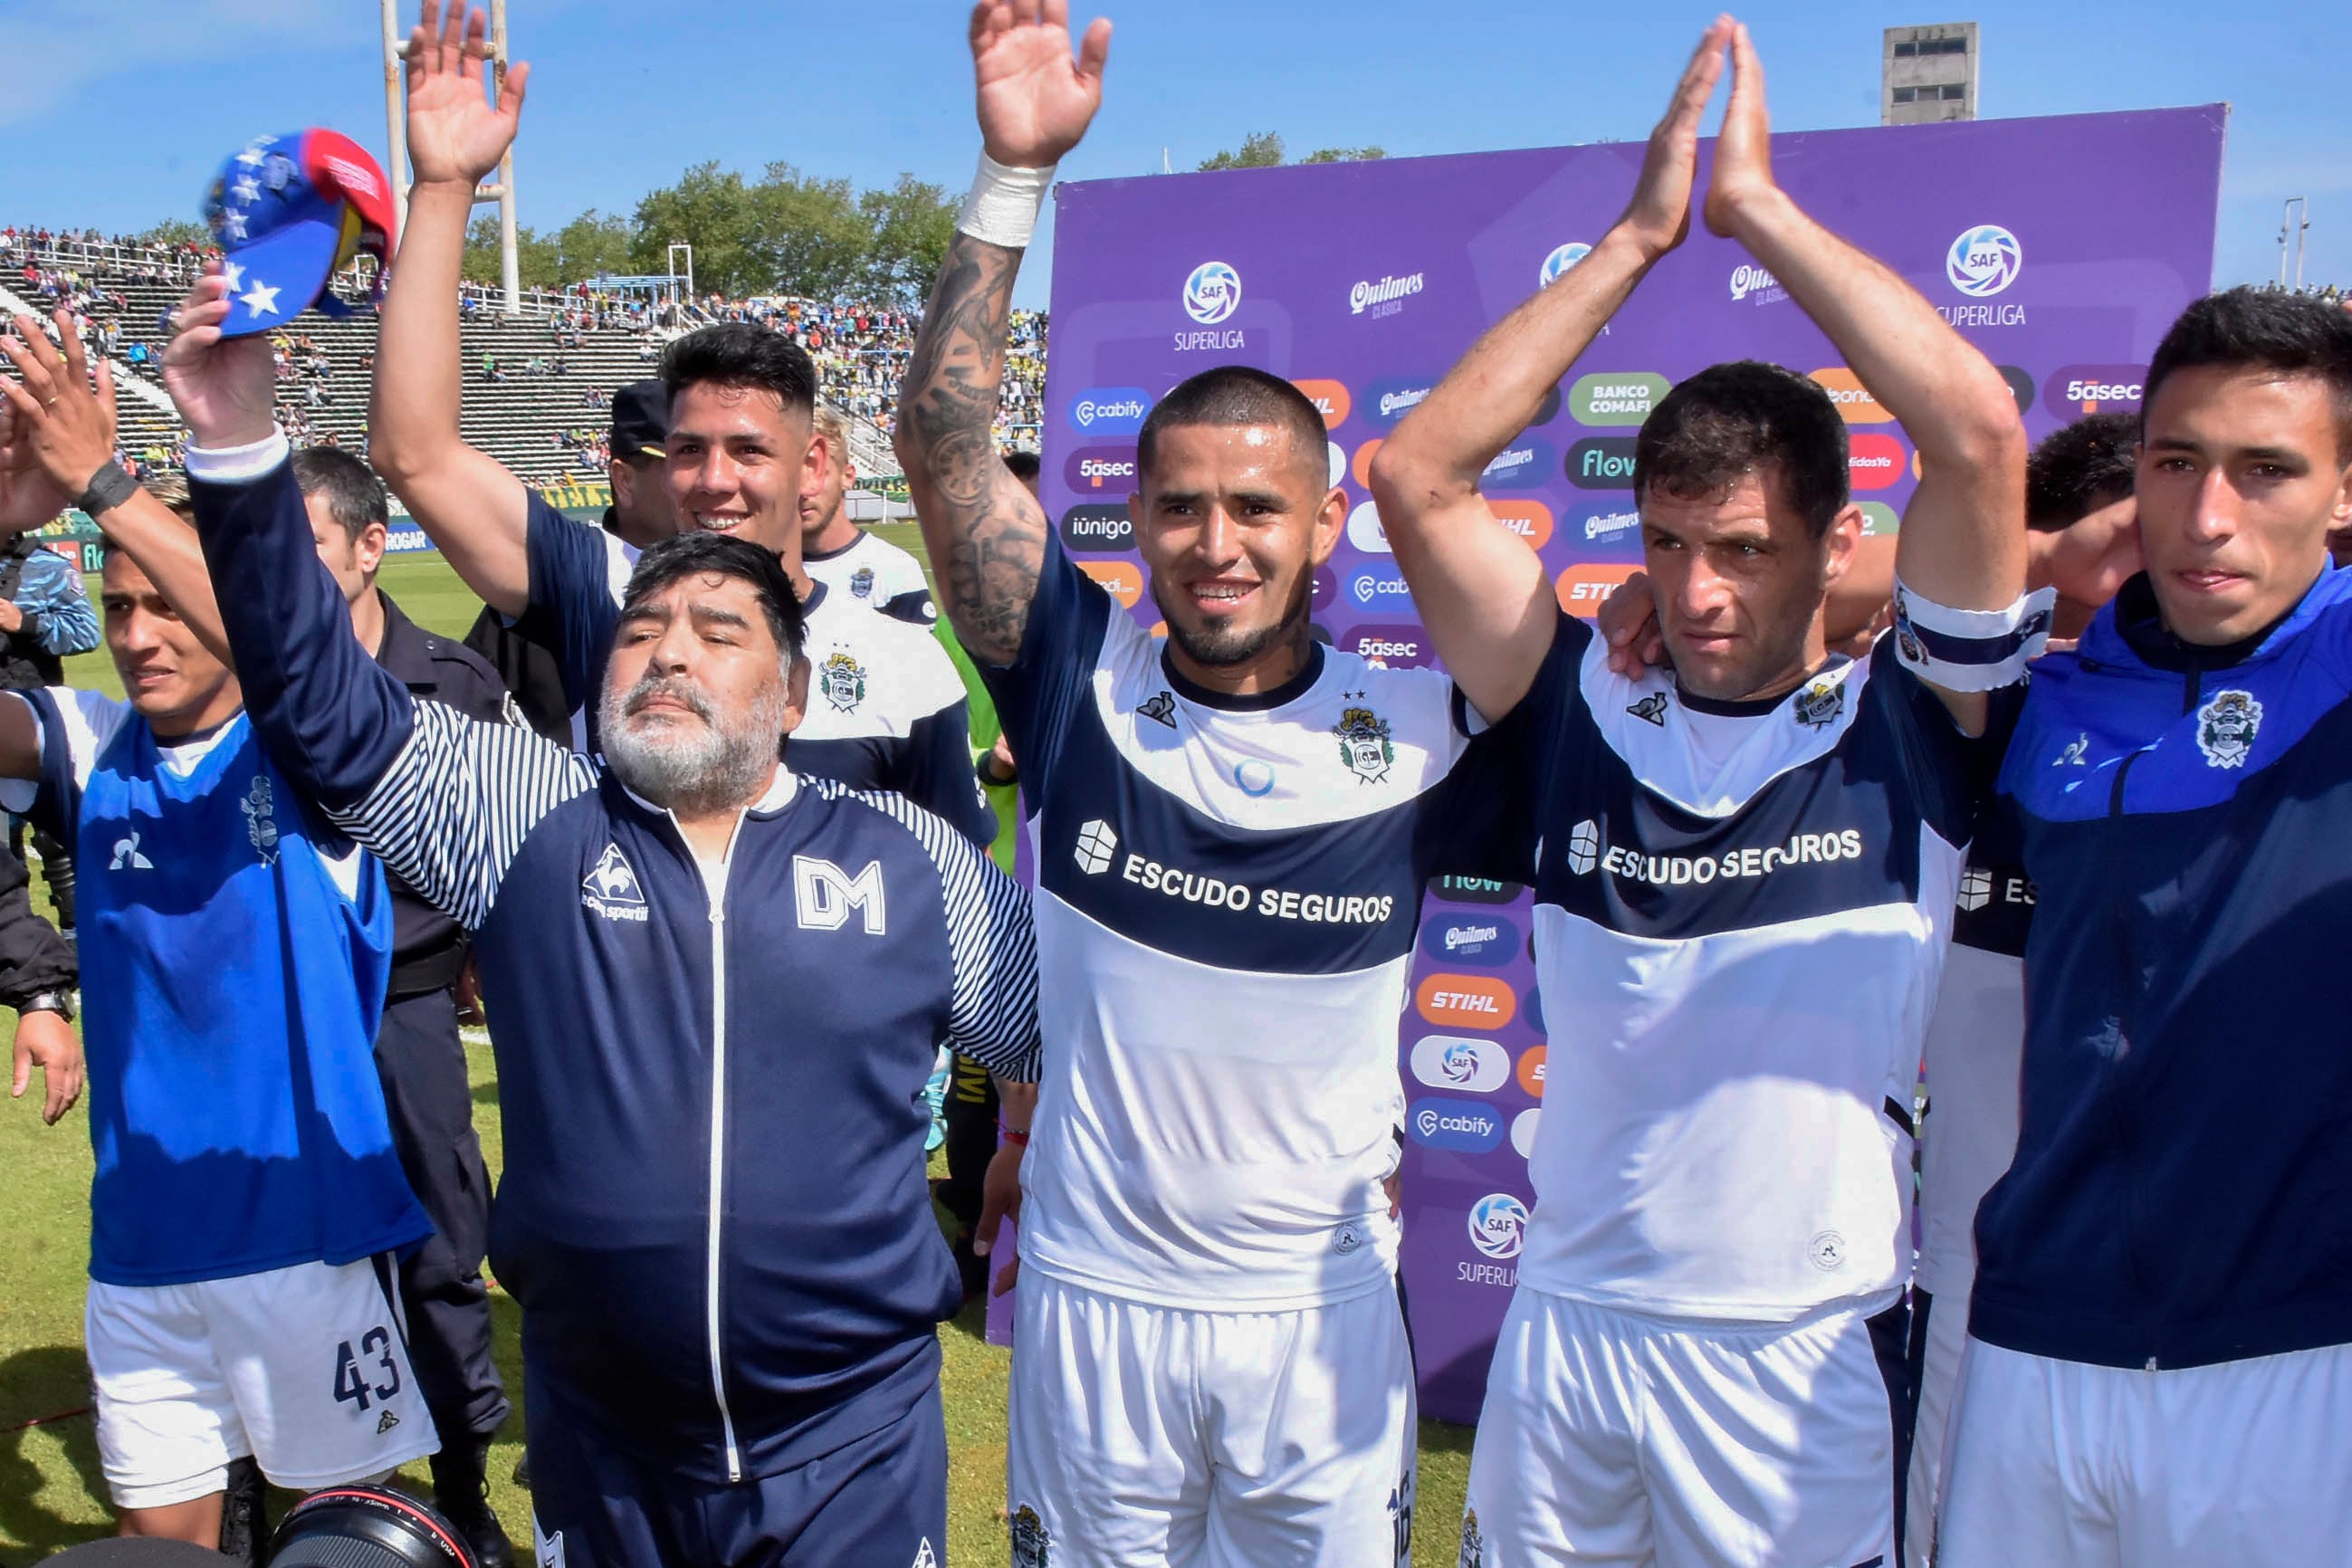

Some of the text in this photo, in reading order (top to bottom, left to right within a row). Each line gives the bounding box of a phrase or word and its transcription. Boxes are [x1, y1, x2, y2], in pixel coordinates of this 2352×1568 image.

[1969, 252, 1999, 268] SAF
[1201, 285, 1223, 299] SAF
[1350, 272, 1423, 315] Quilmes
[1730, 264, 1778, 301] Quil
[1173, 330, 1245, 351] SUPERLIGA
[1593, 386, 1649, 398] BANCO
[1096, 400, 1144, 419] cabify
[1589, 400, 1651, 413] COMAFI
[1585, 512, 1640, 540] Quilmes
[1376, 578, 1410, 594] cab
[1570, 583, 1620, 600] STI
[1601, 846, 1716, 884] ESCUDO
[793, 855, 886, 935] DM
[1123, 854, 1393, 923] ESCUDO SEGUROS
[1445, 925, 1497, 950] Quilmes
[1430, 991, 1498, 1013] STIHL
[1451, 1056, 1470, 1068] SAF
[1440, 1115, 1494, 1137] cabify
[1487, 1219, 1512, 1232] SAF
[1457, 1261, 1518, 1287] SUPERLI
[333, 1325, 401, 1411] 43
